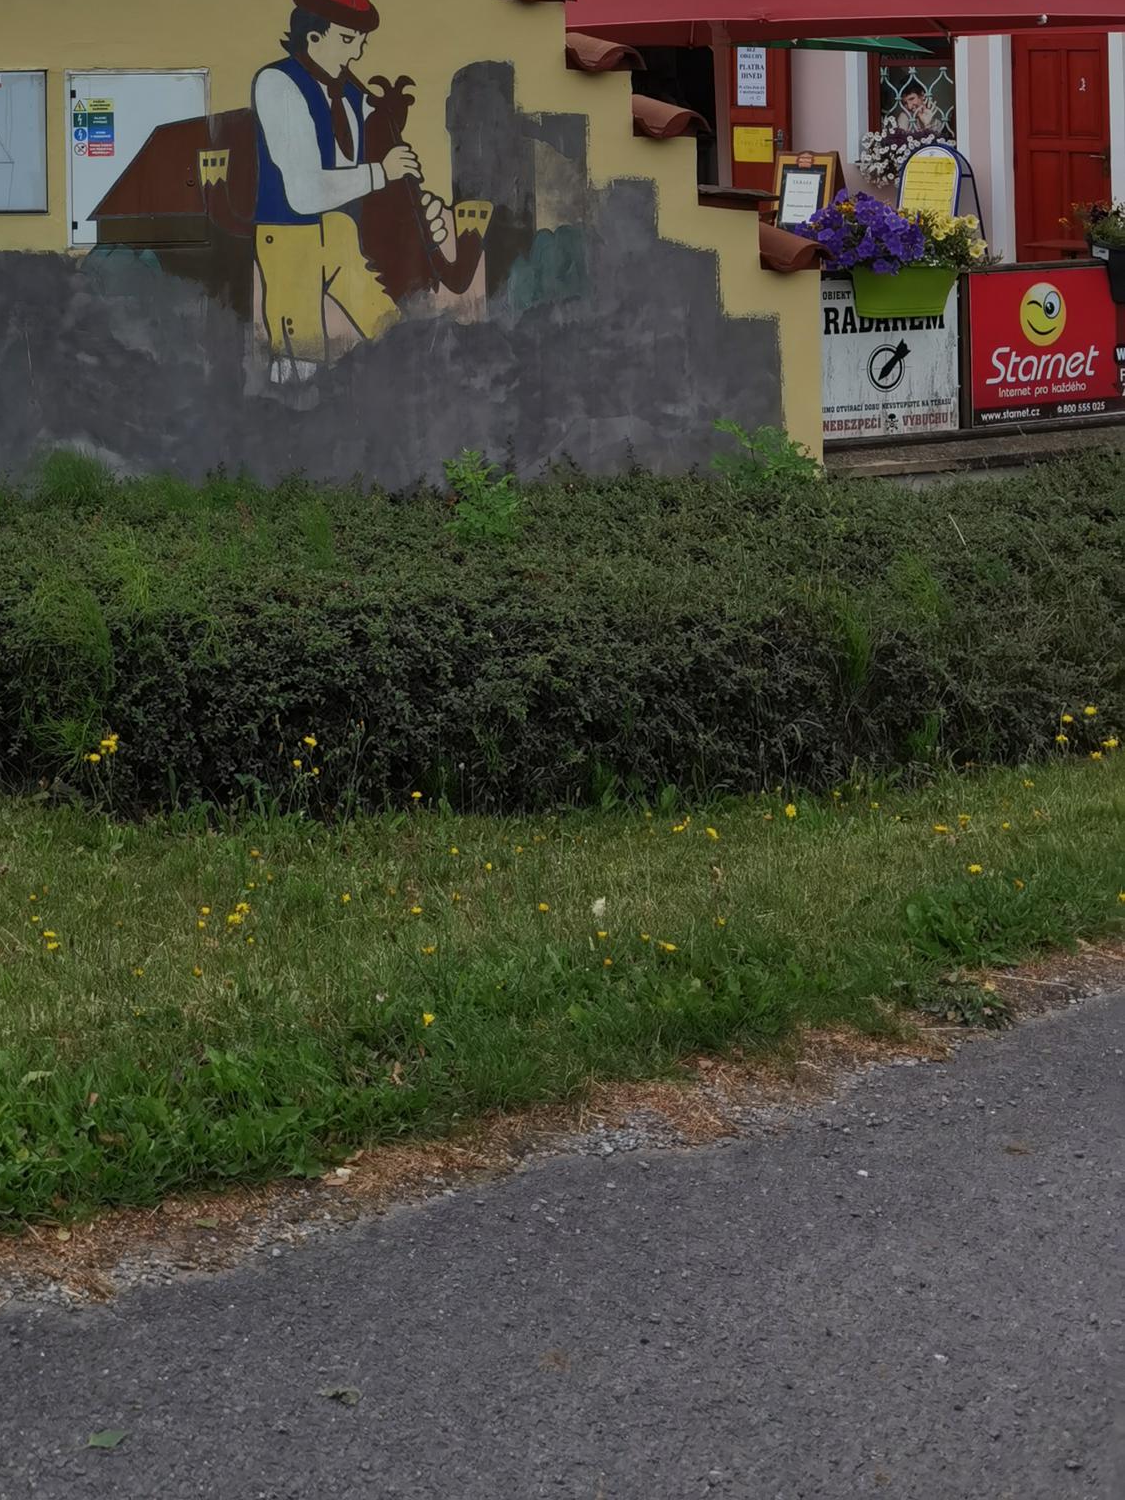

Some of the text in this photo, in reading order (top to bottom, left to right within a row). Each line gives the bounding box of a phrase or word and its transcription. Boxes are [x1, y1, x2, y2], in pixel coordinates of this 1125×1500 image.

[739, 63, 765, 71] PLATBA
[822, 290, 852, 300] OBJEKT
[986, 345, 1100, 385] Starnet
[998, 380, 1087, 398] Internet pro každého
[981, 401, 1106, 421] www.starnet.cz 800 555 025
